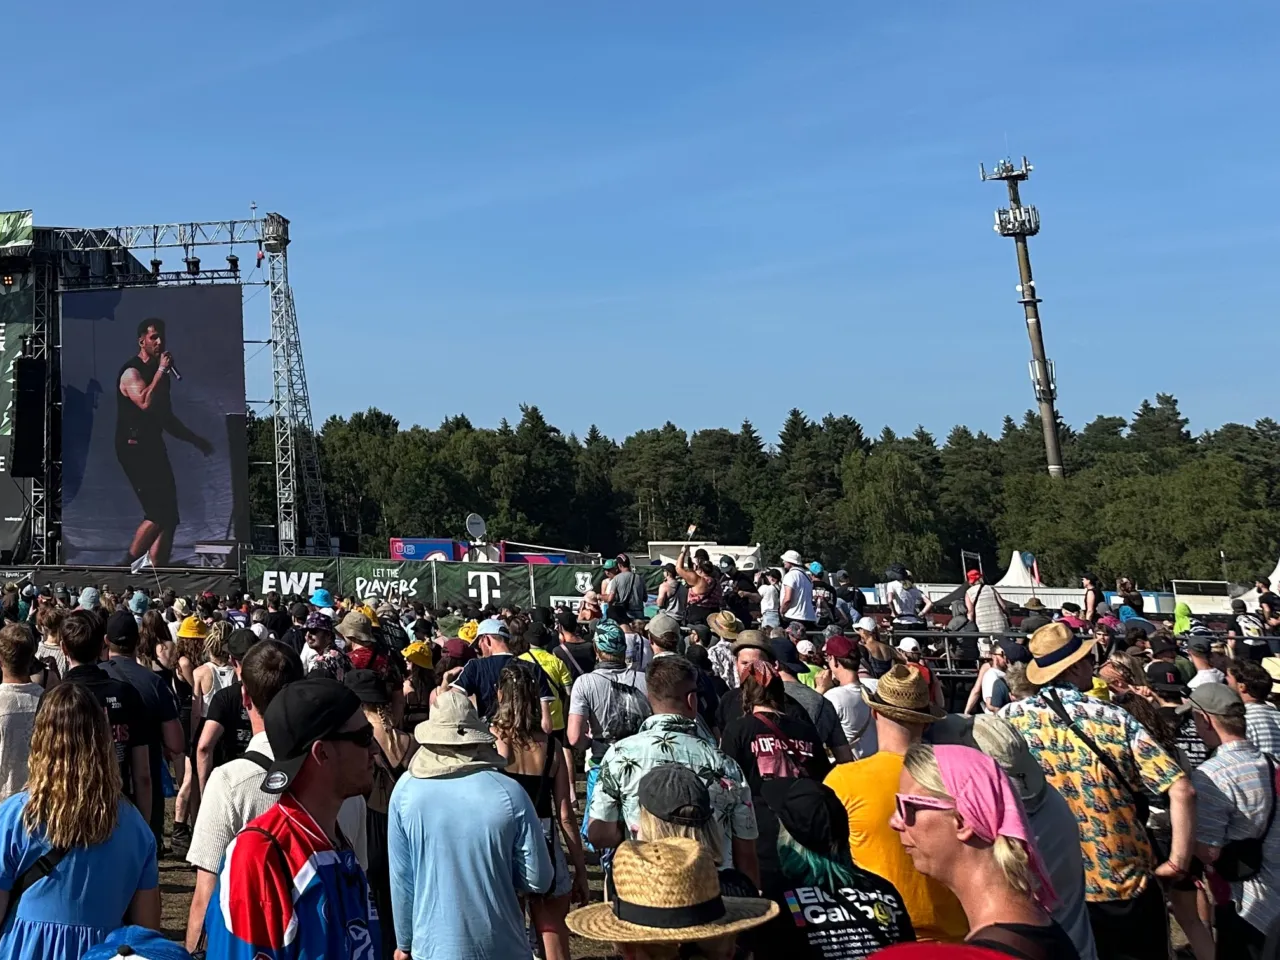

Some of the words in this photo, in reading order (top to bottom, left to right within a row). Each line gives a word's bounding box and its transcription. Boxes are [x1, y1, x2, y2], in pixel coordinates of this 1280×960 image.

[262, 571, 325, 595] EWE
[373, 569, 383, 578] LET
[388, 569, 400, 578] THE
[355, 576, 419, 599] PLAYERS
[468, 571, 501, 611] T
